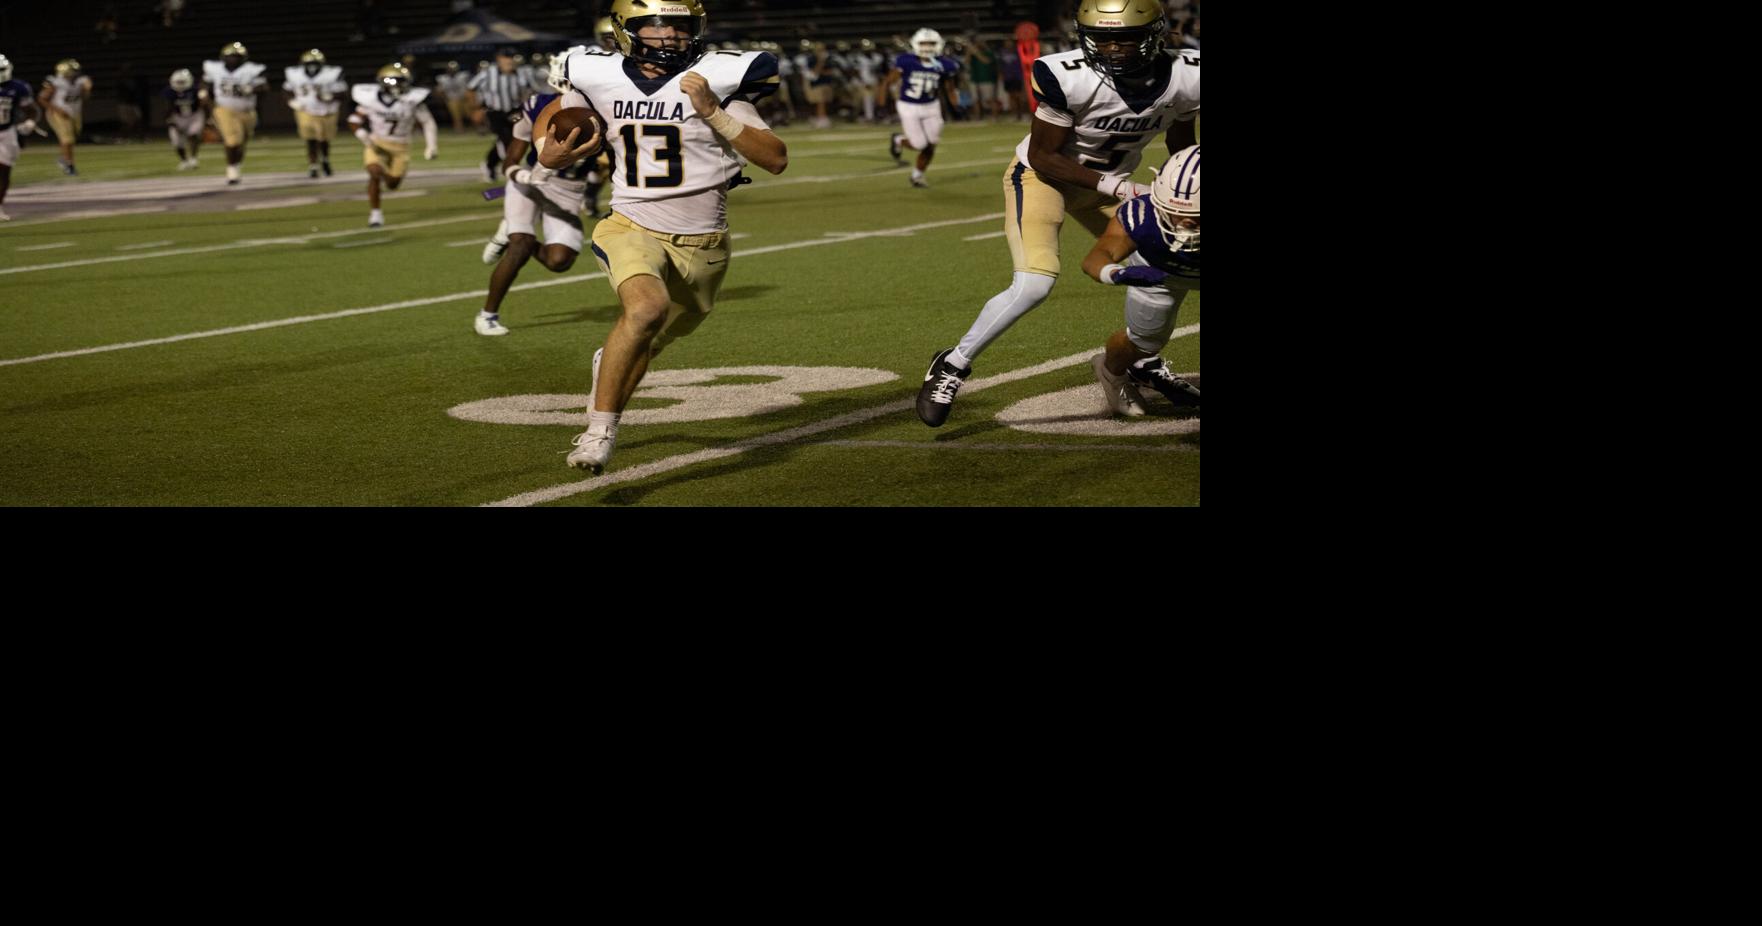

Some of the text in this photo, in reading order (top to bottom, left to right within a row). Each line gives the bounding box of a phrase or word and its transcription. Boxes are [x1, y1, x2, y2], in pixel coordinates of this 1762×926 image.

[613, 100, 684, 121] DACULA
[1094, 115, 1163, 132] DACULA
[619, 124, 684, 188] 13
[1086, 134, 1143, 172] 5
